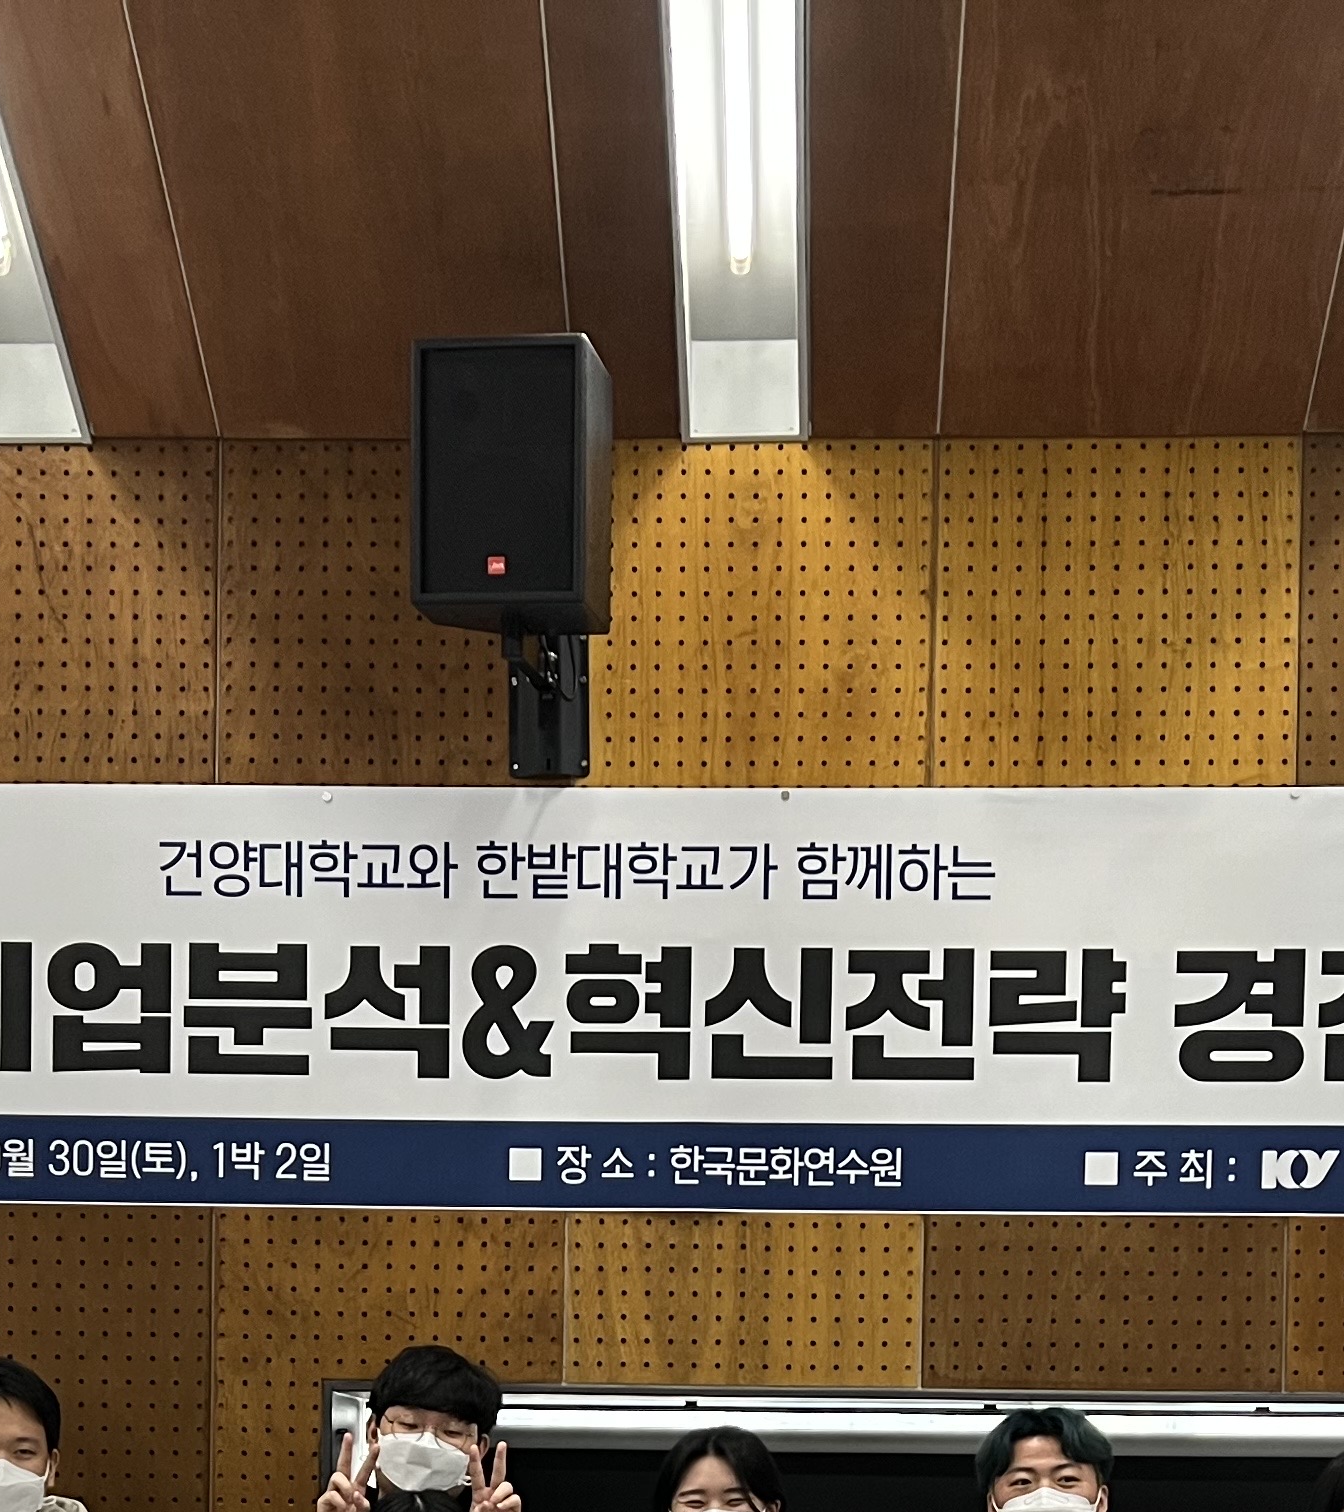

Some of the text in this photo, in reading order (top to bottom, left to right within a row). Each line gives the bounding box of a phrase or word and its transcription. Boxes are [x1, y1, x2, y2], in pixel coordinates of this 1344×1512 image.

[160, 839, 996, 901] 건양대학교와 한밭대학교가 함께하는
[48, 1139, 198, 1182] 30일(토),
[212, 1141, 266, 1181] 1박
[275, 1142, 330, 1182] 2일
[669, 1144, 902, 1187] 한국문화연수원
[1261, 1149, 1341, 1190] KY
